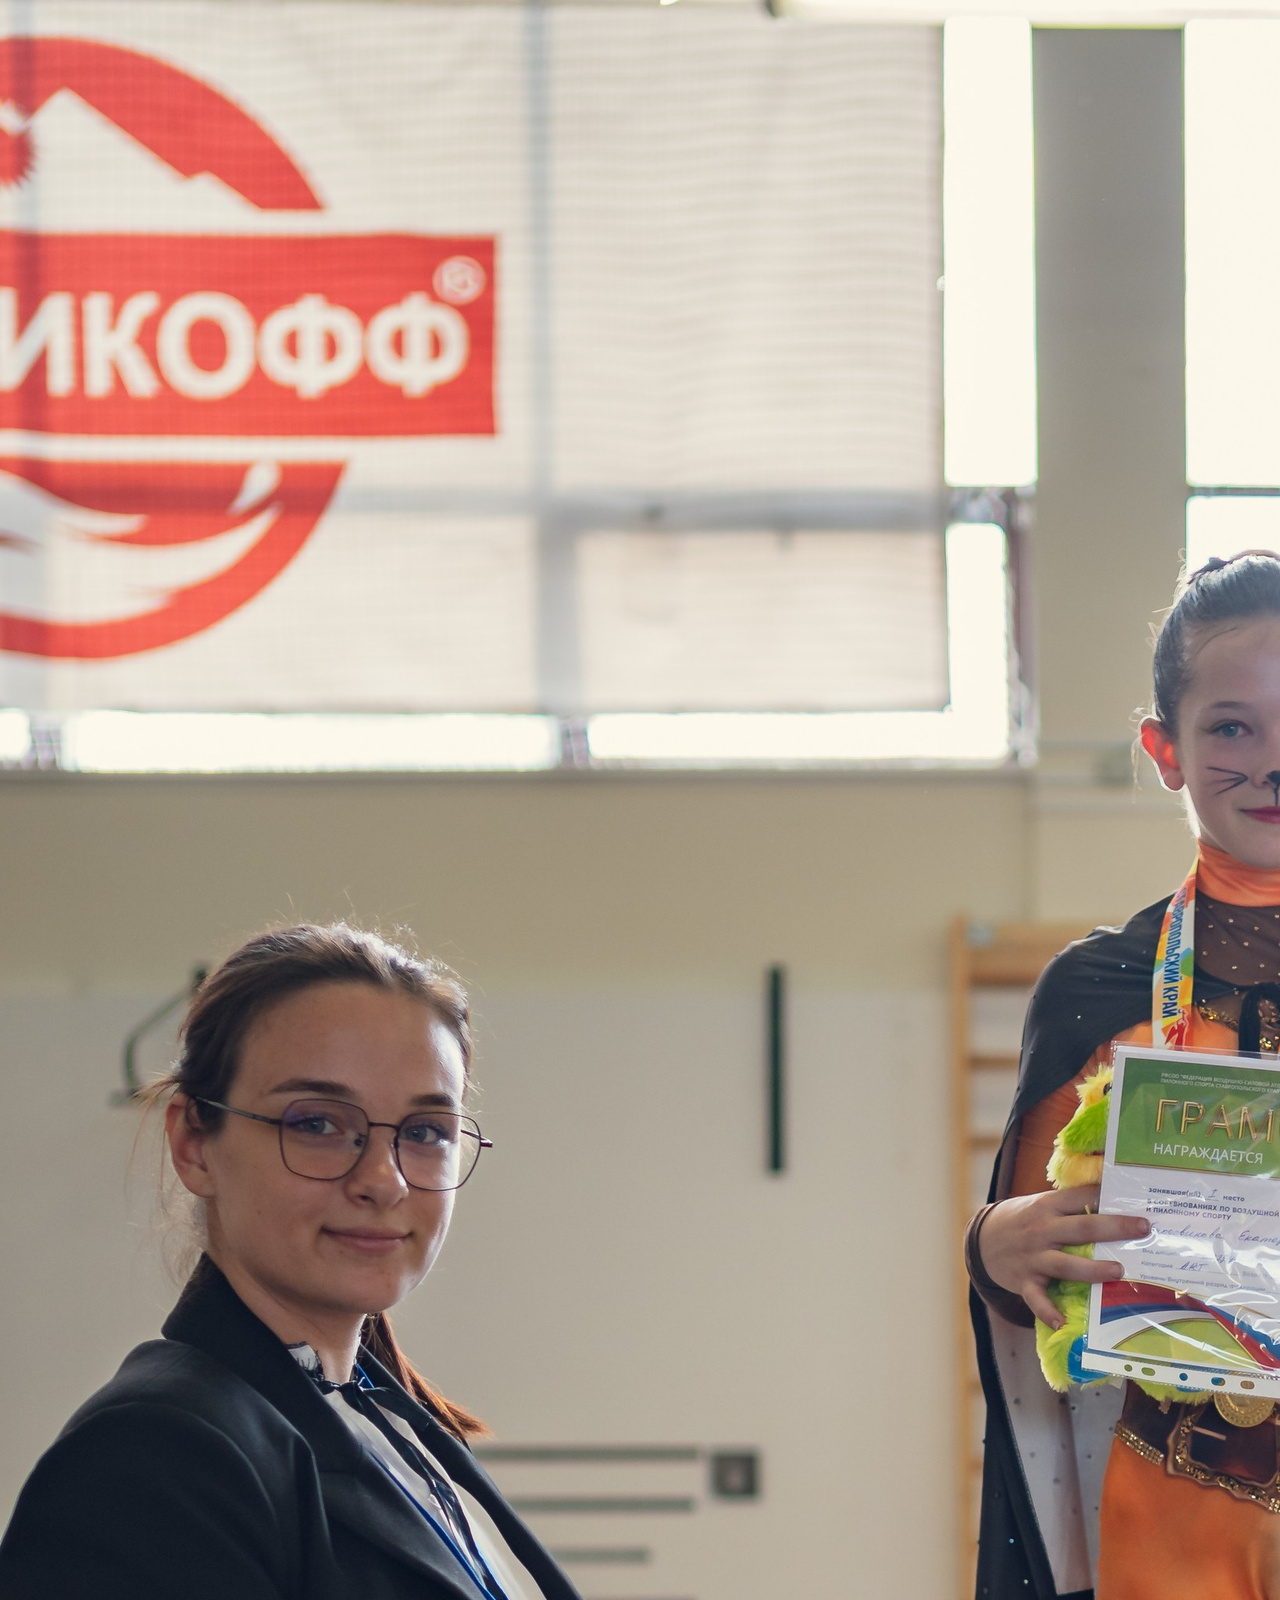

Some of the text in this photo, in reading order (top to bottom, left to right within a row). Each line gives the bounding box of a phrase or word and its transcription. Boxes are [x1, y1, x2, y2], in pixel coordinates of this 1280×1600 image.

[1162, 985, 1181, 1018] КРАЙ
[1153, 1142, 1264, 1165] НАГРАЖДАЕТСЯ
[1153, 1207, 1201, 1218] ПИЛОННОМУ
[1202, 1212, 1232, 1221] СПОРТУ
[1219, 1205, 1231, 1213] ПО
[1232, 1207, 1280, 1218] ВОЗДУШНОЙ
